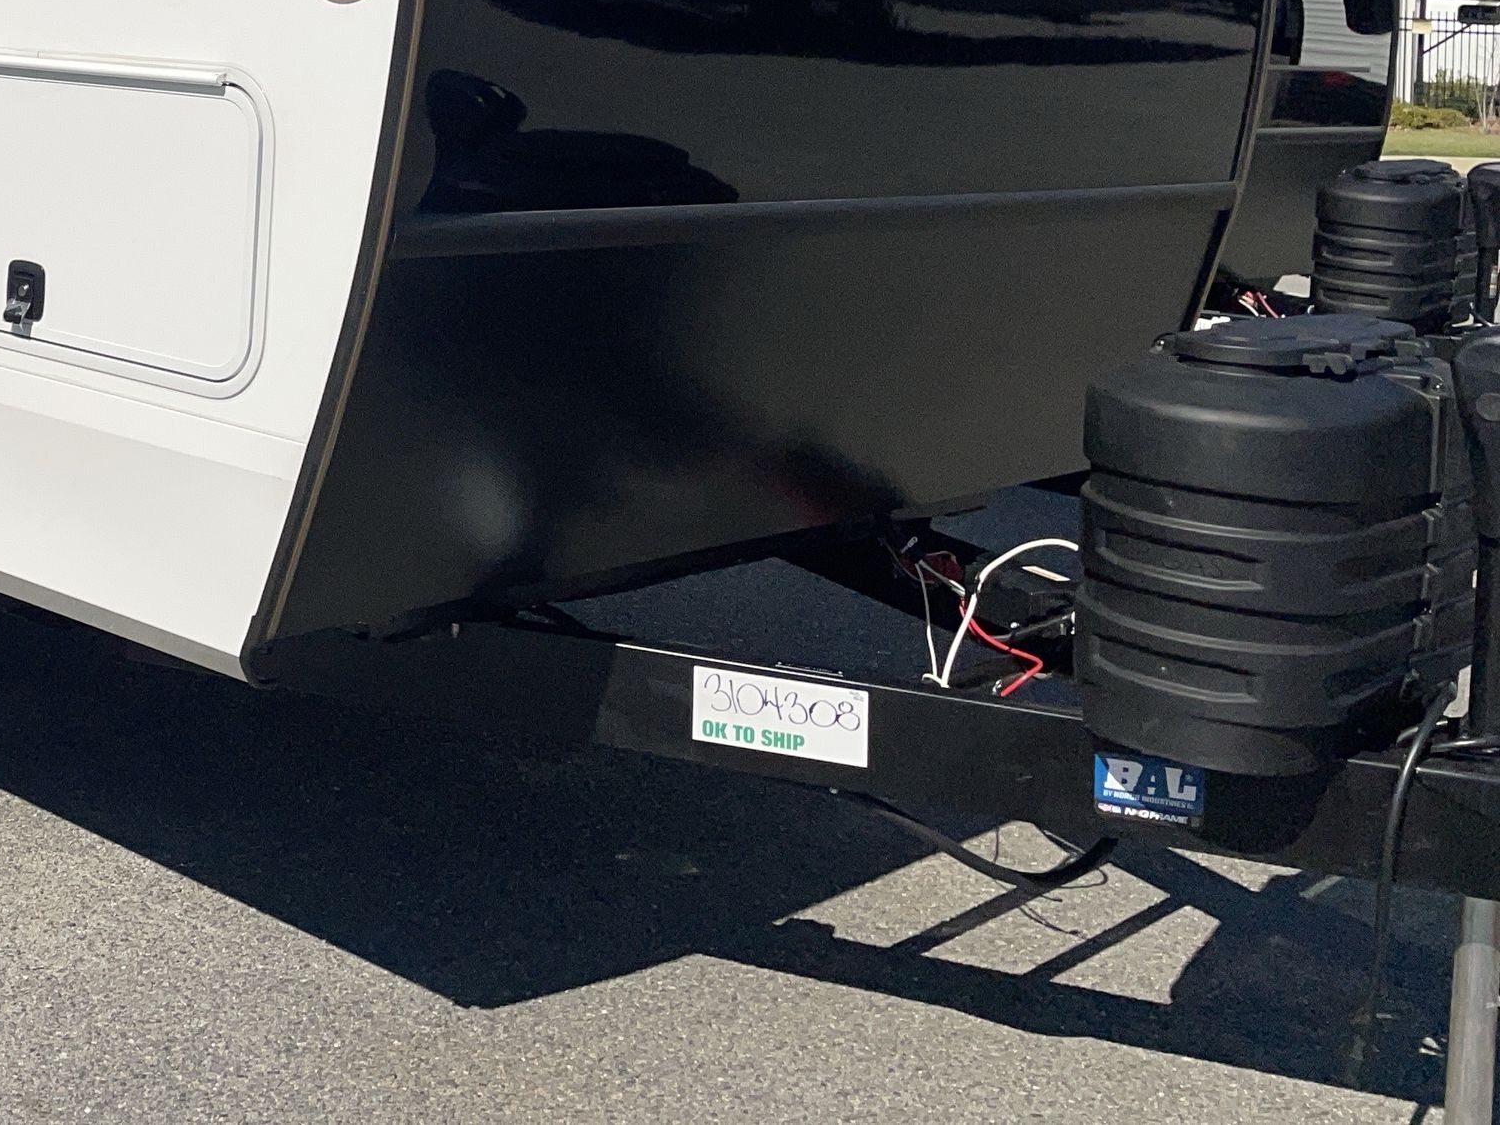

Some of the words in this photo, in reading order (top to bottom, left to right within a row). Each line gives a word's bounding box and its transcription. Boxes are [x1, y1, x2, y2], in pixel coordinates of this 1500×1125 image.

[704, 673, 861, 732] 3104308
[702, 719, 728, 740] OK
[732, 724, 756, 744] TO
[761, 729, 805, 751] SHIP
[1103, 758, 1197, 802] BAL
[1103, 789, 1113, 797] BY
[1141, 795, 1187, 809] INDUSTRIES
